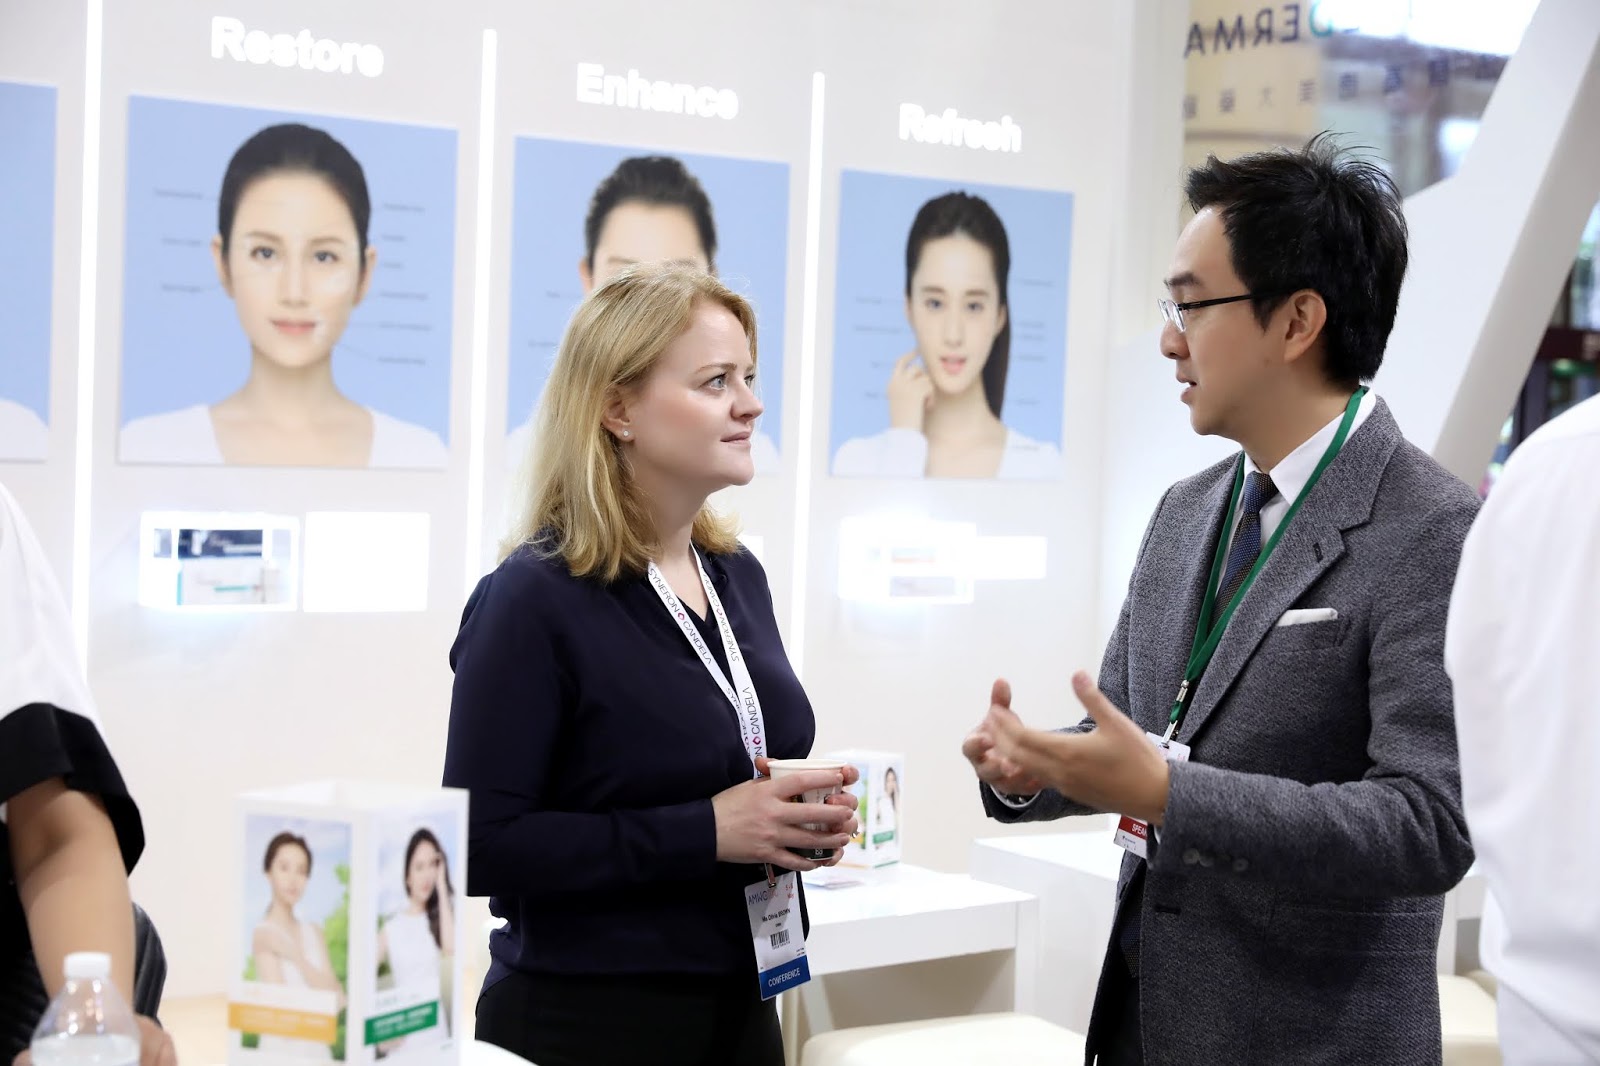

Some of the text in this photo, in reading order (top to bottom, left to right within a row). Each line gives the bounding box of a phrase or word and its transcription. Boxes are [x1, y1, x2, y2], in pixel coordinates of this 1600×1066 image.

[211, 15, 384, 77] Restore
[577, 62, 739, 120] Enhance
[899, 102, 1022, 152] Refresh
[649, 567, 712, 665] SYNERON CANDELA
[742, 686, 761, 735] CANDELA
[768, 967, 801, 988] CONFERENCE
